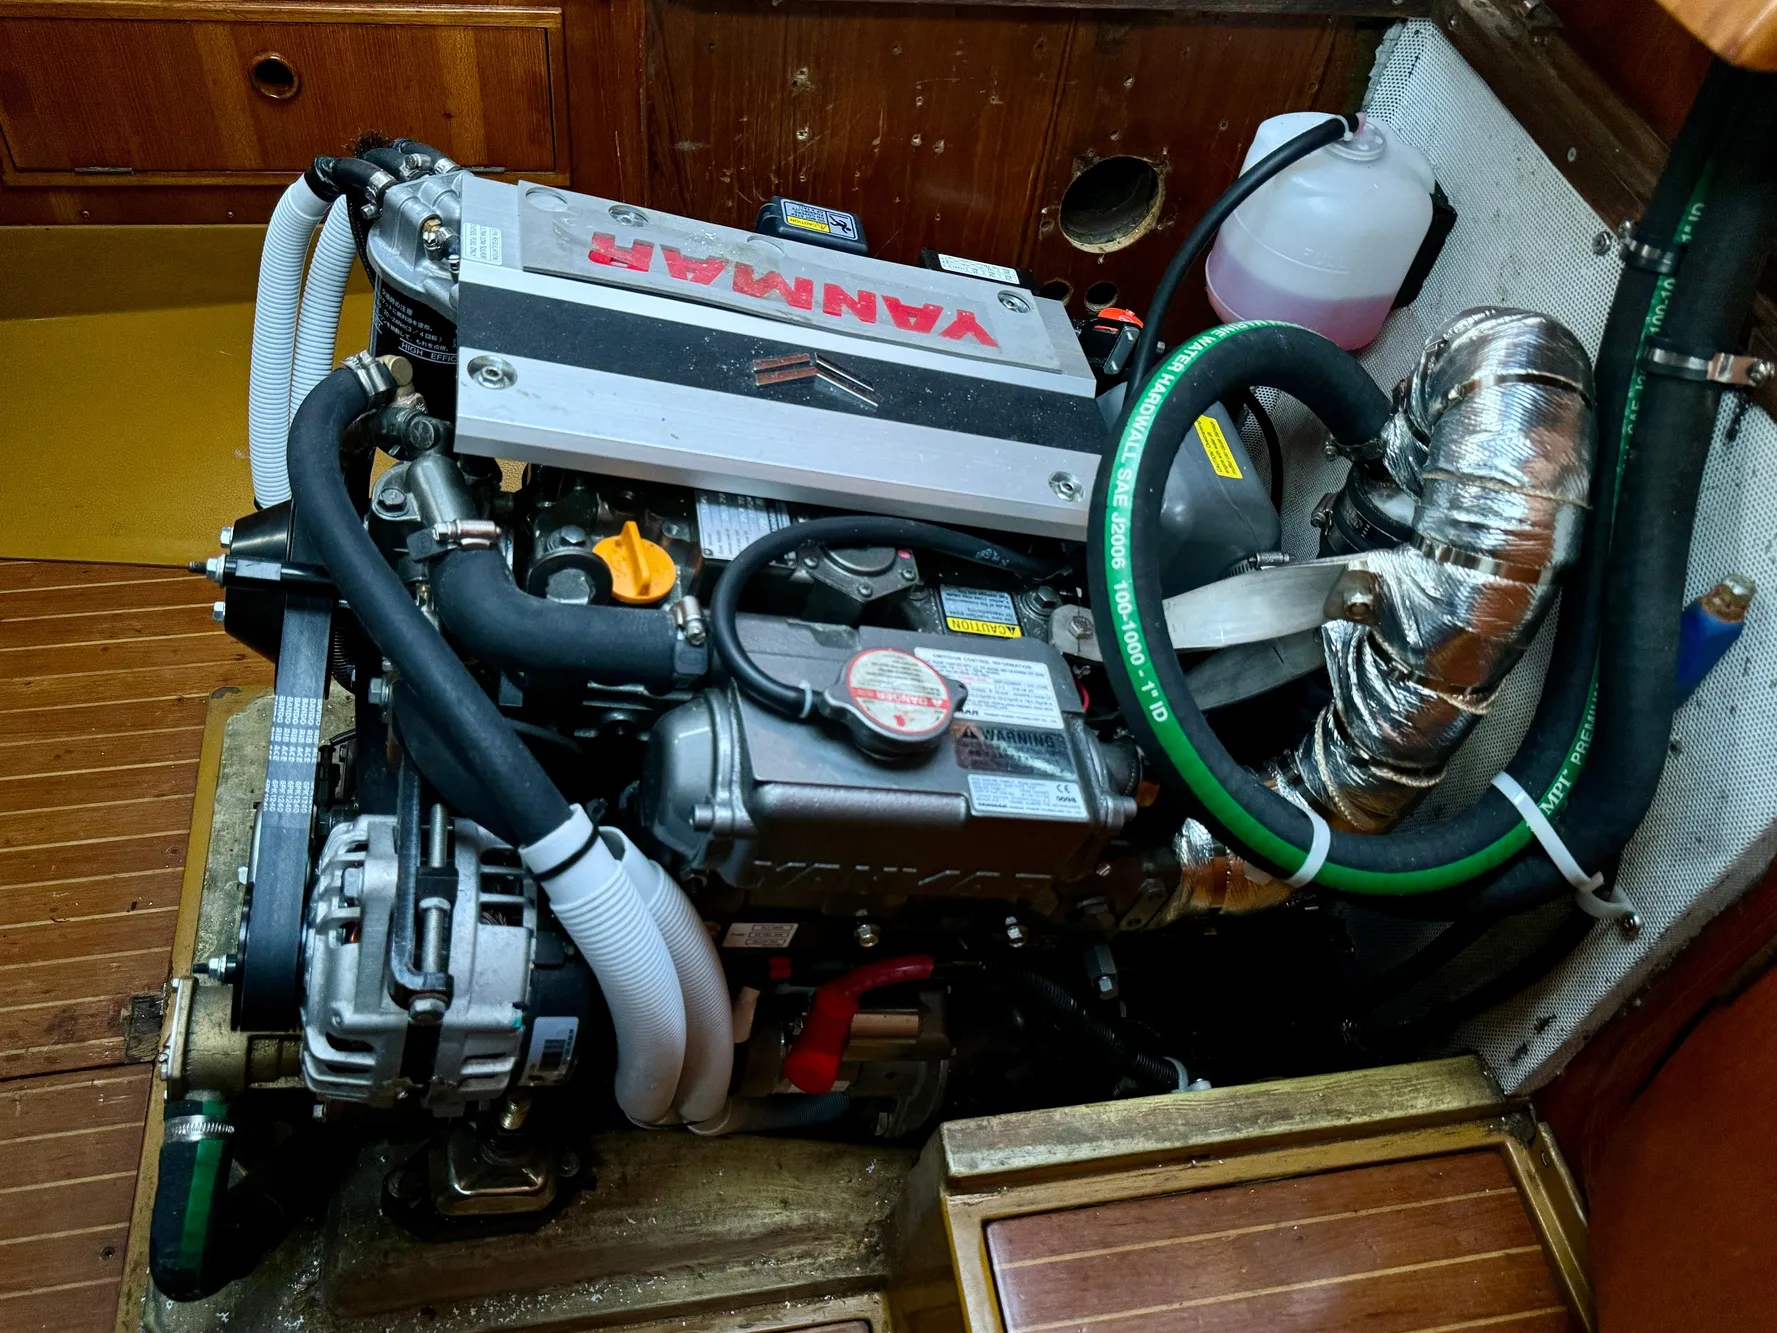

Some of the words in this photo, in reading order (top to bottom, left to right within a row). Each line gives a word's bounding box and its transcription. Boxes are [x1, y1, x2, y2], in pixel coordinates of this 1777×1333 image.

[790, 218, 816, 227] CAUTION
[588, 231, 999, 348] YANMAR
[402, 341, 423, 357] HIGH
[1172, 335, 1213, 373] WATER
[1120, 373, 1176, 463] HARDWALL
[1209, 451, 1222, 473] CAUTION
[1112, 467, 1132, 508] SAE
[1110, 512, 1126, 570] J2006
[952, 620, 1005, 634] CAUTION
[1114, 580, 1146, 667] 100-1000
[876, 691, 928, 706] DANGER
[1149, 701, 1168, 722] ID
[983, 728, 1055, 748] WARNING
